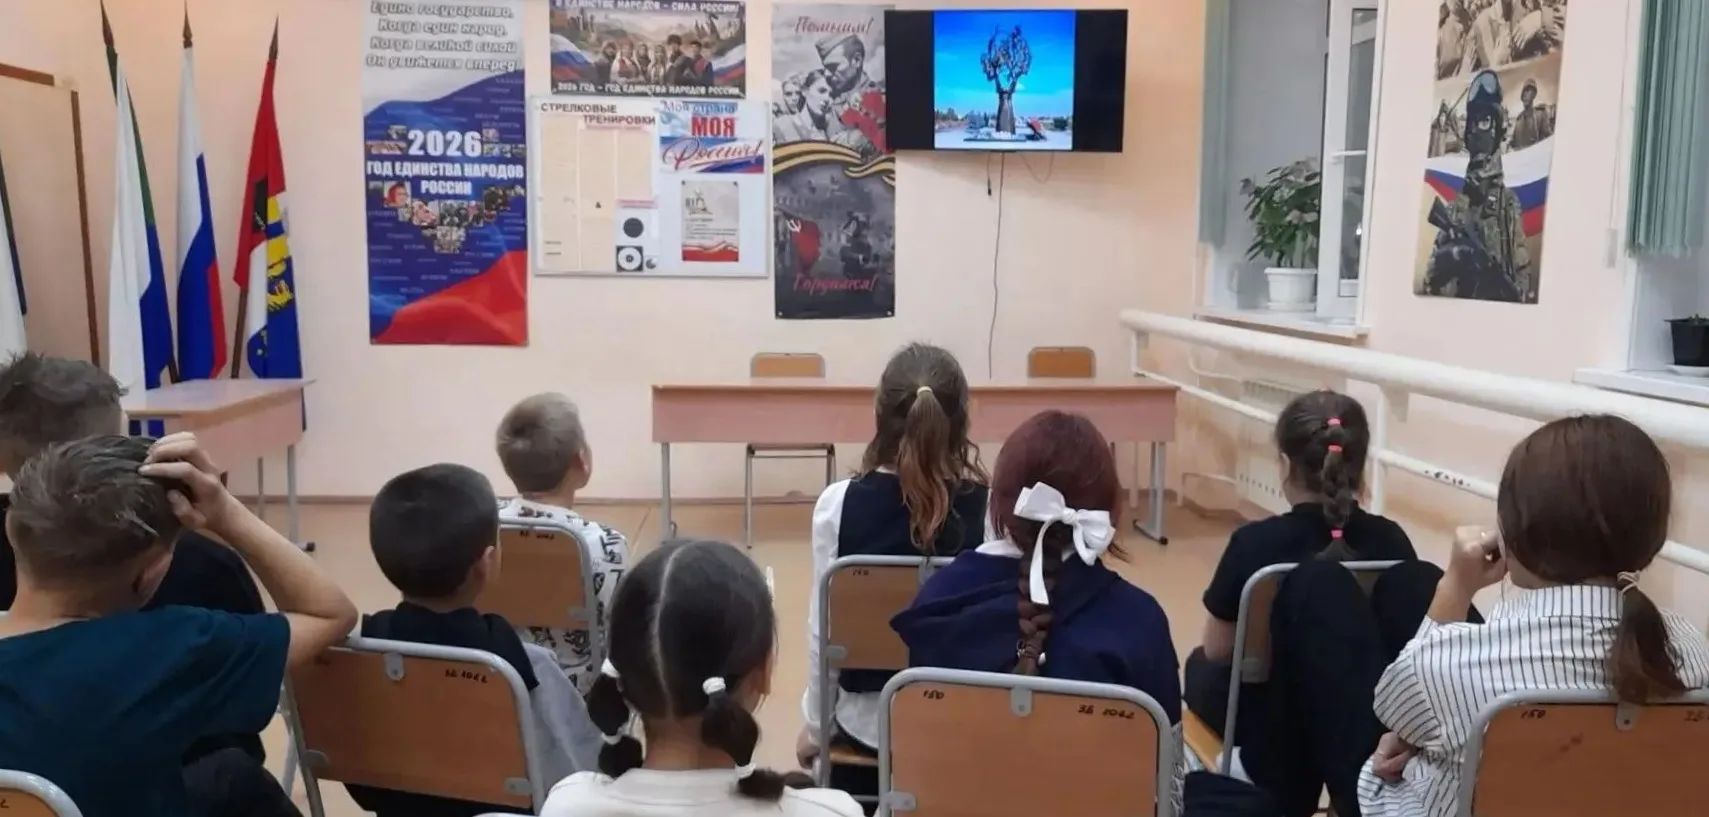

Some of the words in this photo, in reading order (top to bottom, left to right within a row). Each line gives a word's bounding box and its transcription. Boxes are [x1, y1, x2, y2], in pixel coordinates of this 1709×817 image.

[671, 2, 698, 12] СИЛА
[541, 103, 618, 114] СТРЕЛКОВЫЕ
[583, 115, 656, 126] ТРЕНИРОВКИ
[691, 116, 735, 137] МОЯ
[408, 130, 482, 157] 2026
[366, 160, 393, 177] ГОД
[395, 161, 462, 177] ЕДИНСТВА
[464, 163, 524, 180] НАРОДОВ
[420, 180, 473, 196] РОССИИ
